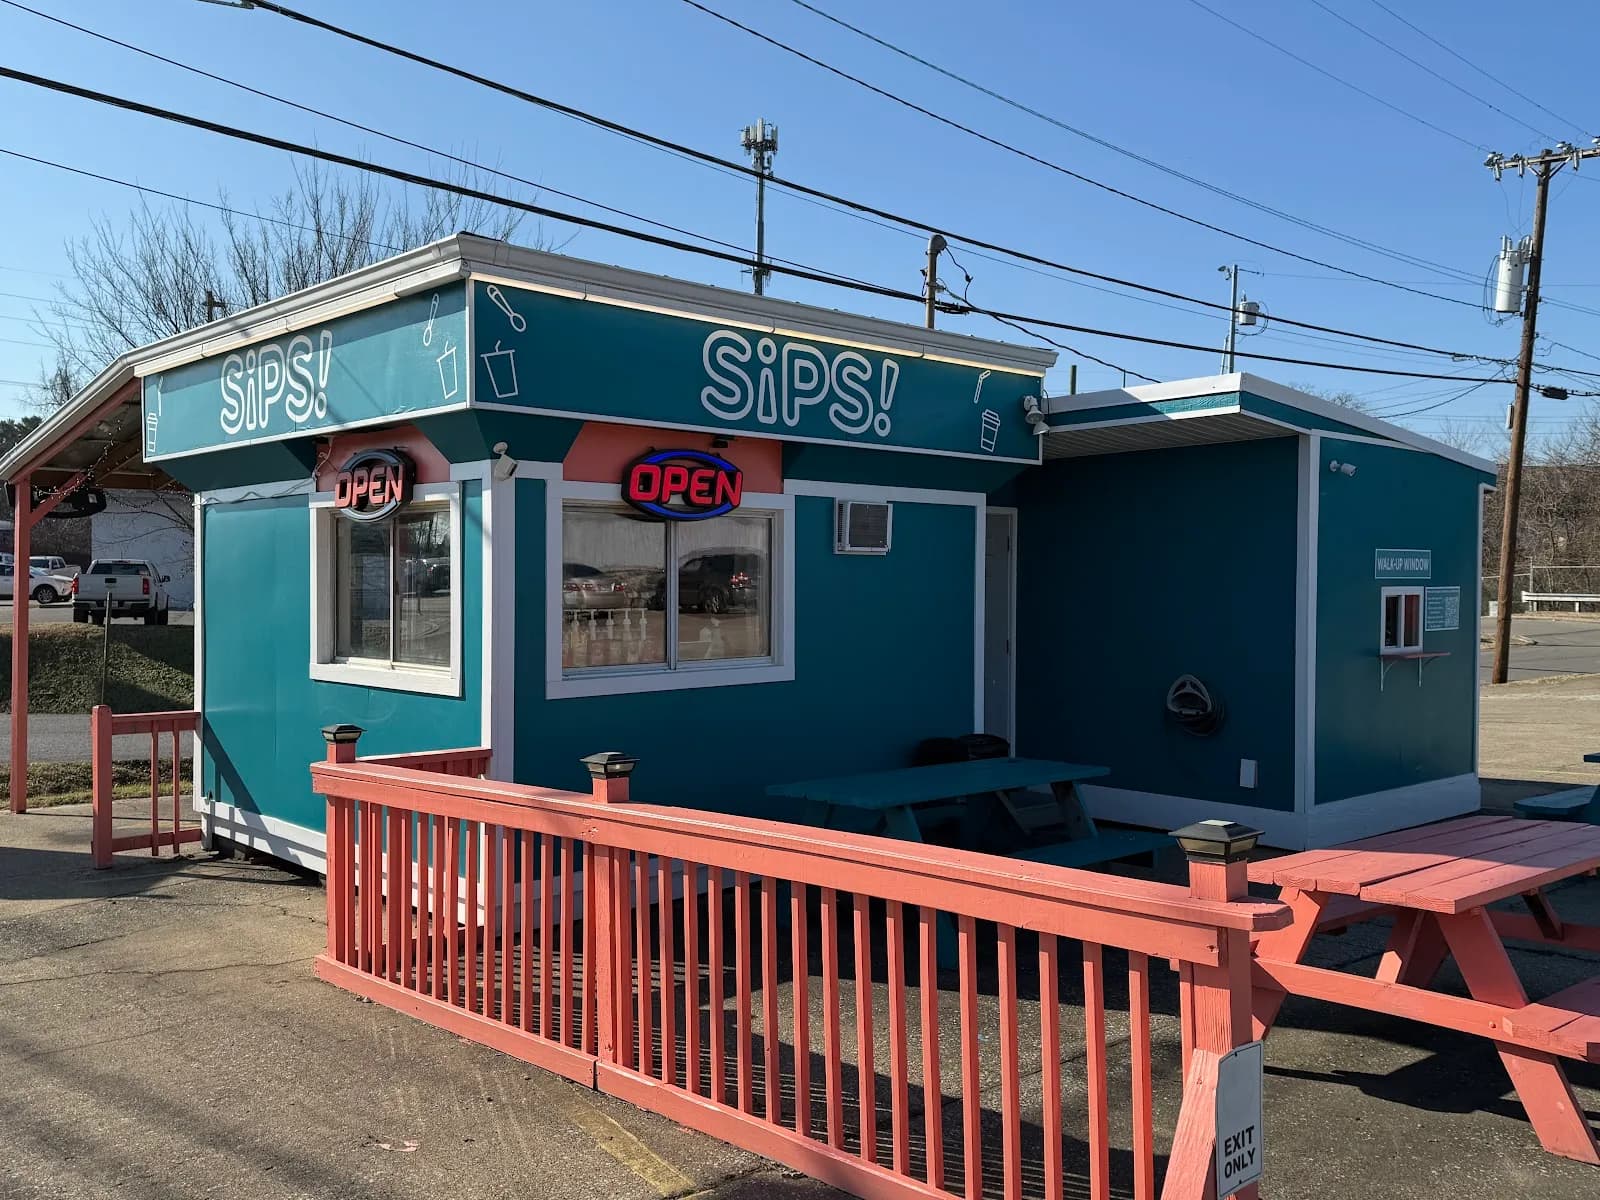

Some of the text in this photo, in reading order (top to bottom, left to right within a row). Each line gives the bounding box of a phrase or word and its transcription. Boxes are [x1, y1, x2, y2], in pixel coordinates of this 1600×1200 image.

[334, 464, 404, 509] OPEN
[628, 463, 743, 507] OPEN
[1377, 557, 1429, 571] WALK-UP WINDOW
[1224, 1125, 1255, 1158] EXIT
[1224, 1148, 1256, 1178] ONLY
